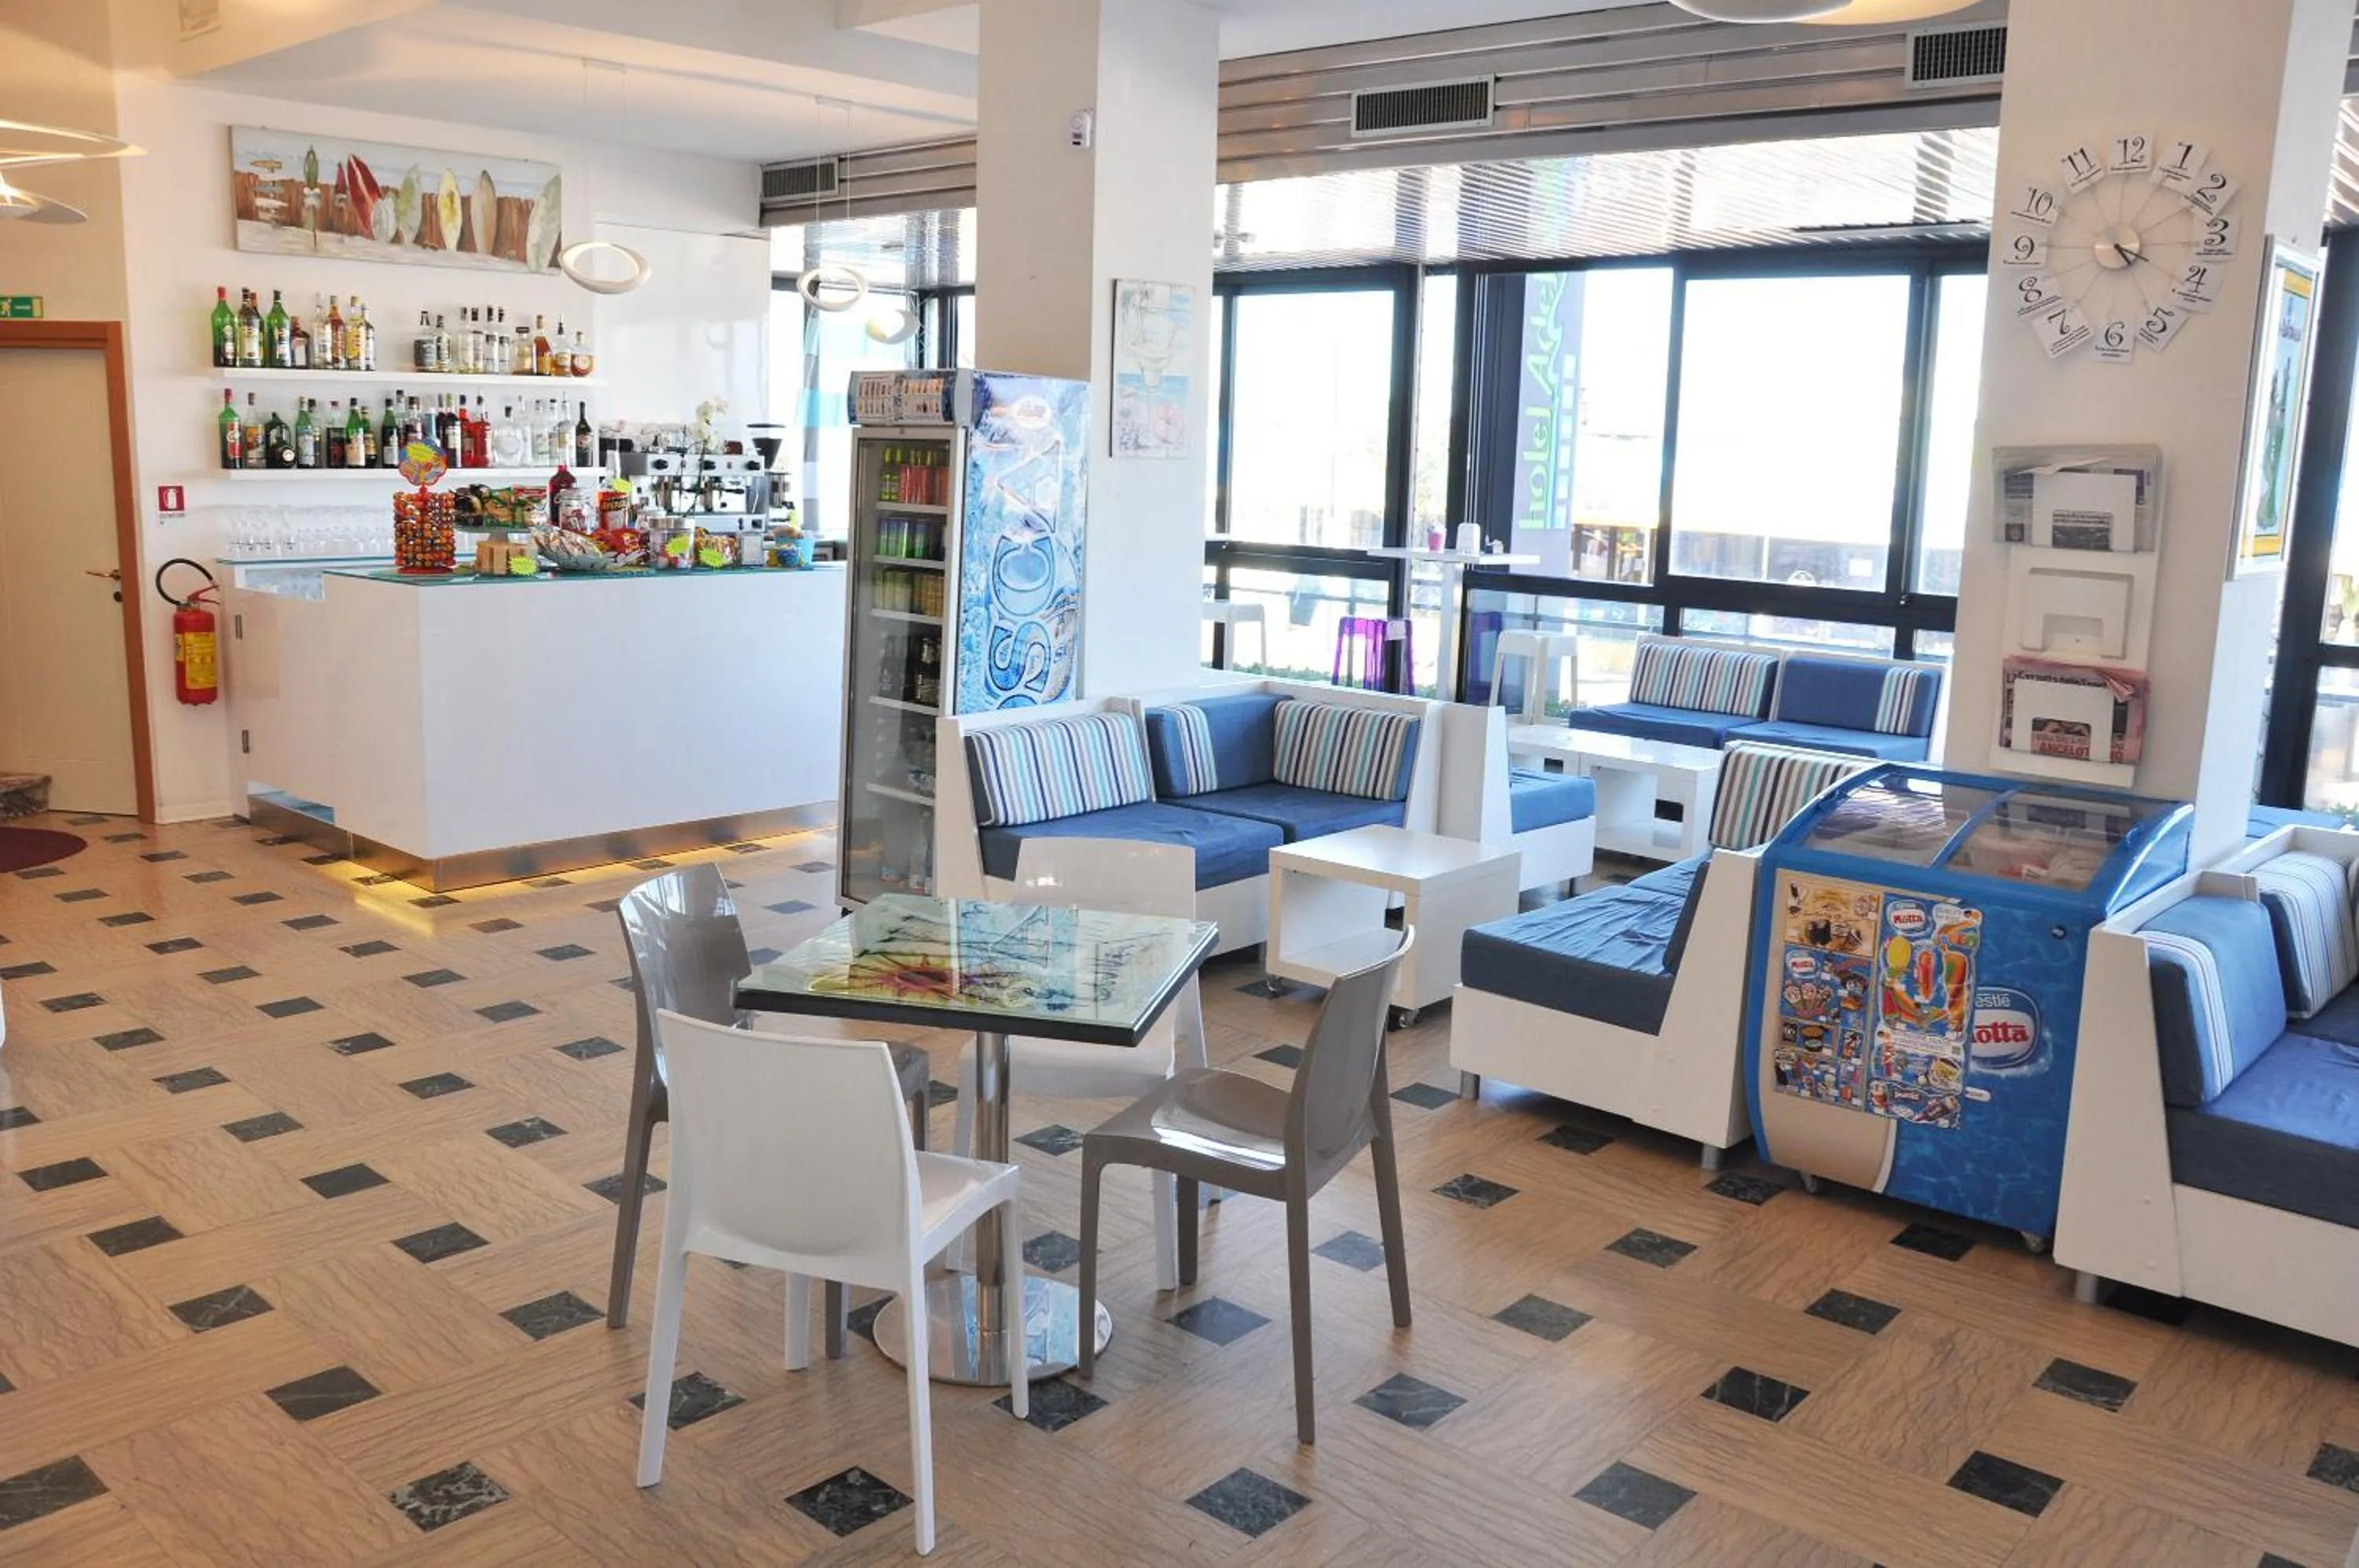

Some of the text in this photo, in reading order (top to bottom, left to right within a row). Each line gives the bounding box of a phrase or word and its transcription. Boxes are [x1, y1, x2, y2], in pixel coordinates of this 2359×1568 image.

[2061, 147, 2096, 179] 11
[2117, 136, 2145, 165] 12
[2177, 142, 2194, 171] 1
[2027, 186, 2055, 216] 10
[2196, 173, 2227, 203] 2
[2204, 218, 2229, 246] 3
[2014, 235, 2035, 261] 9
[2018, 276, 2043, 303] 8
[2185, 265, 2207, 293] 4
[2048, 308, 2071, 336] 7
[2103, 322, 2125, 347] 6
[2146, 307, 2175, 335] 5
[988, 440, 1062, 710] SCA
[1971, 1021, 2030, 1043] otta
